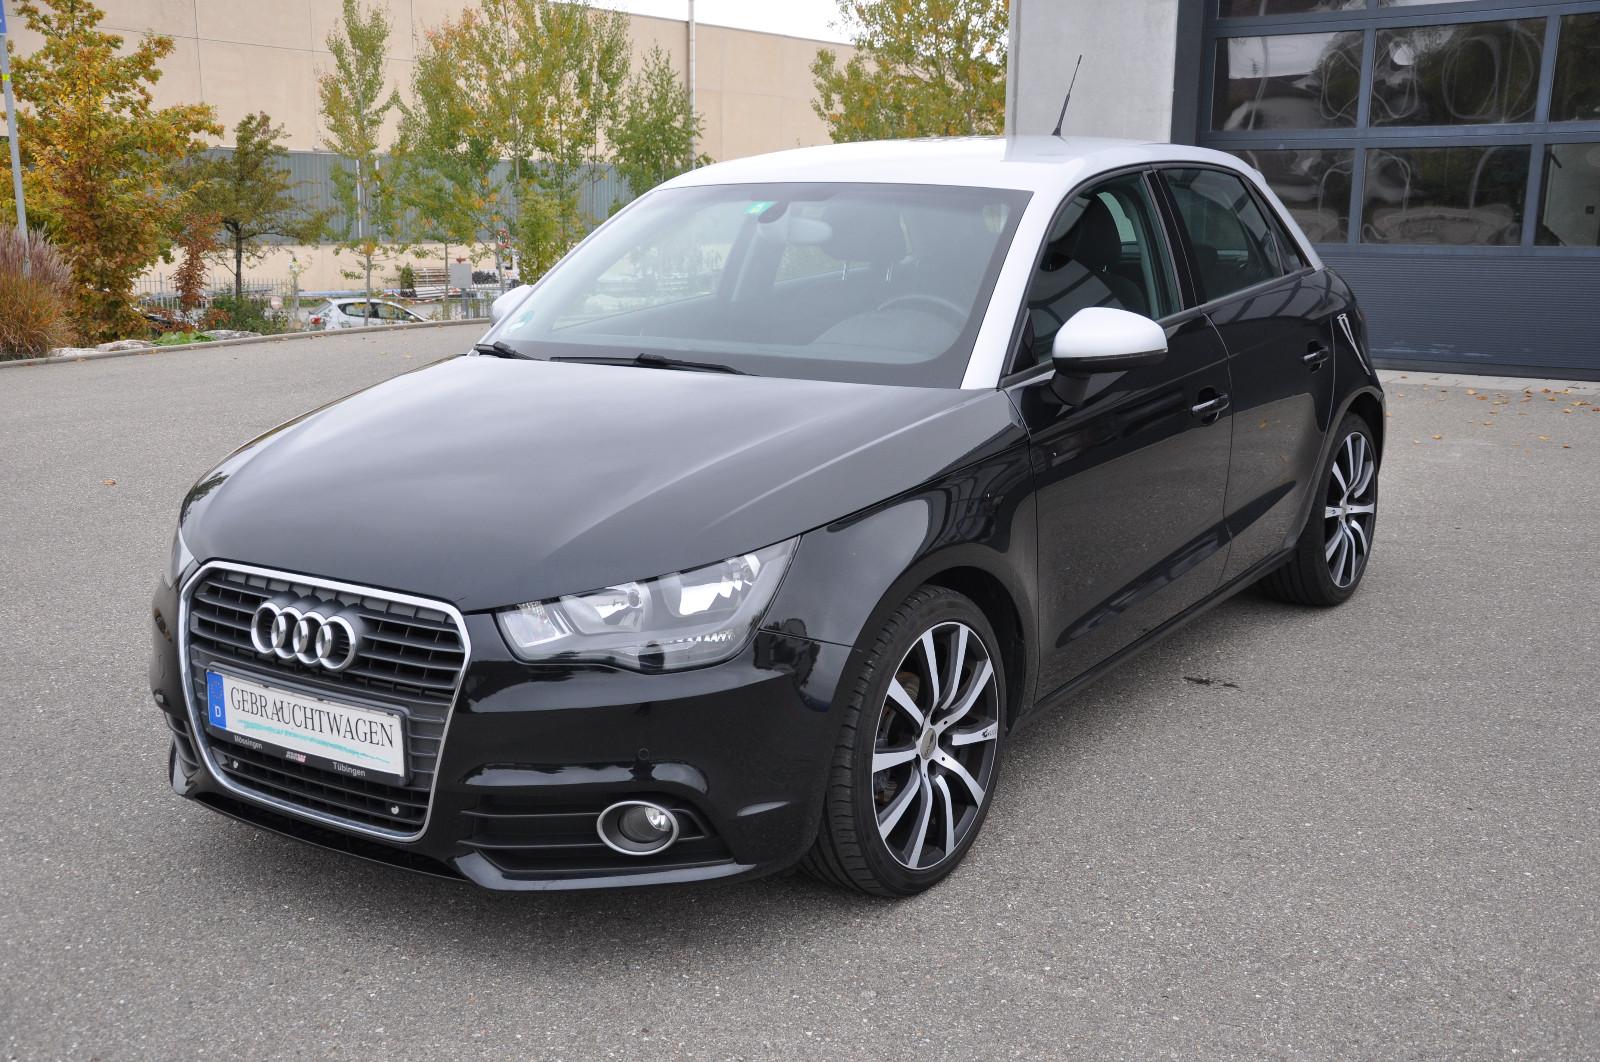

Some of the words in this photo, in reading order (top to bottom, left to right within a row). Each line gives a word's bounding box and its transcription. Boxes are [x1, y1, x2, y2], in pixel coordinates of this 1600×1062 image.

[215, 705, 222, 718] D
[231, 687, 394, 748] GEBRAUCHTWAGEN
[332, 762, 366, 777] Tübingen
